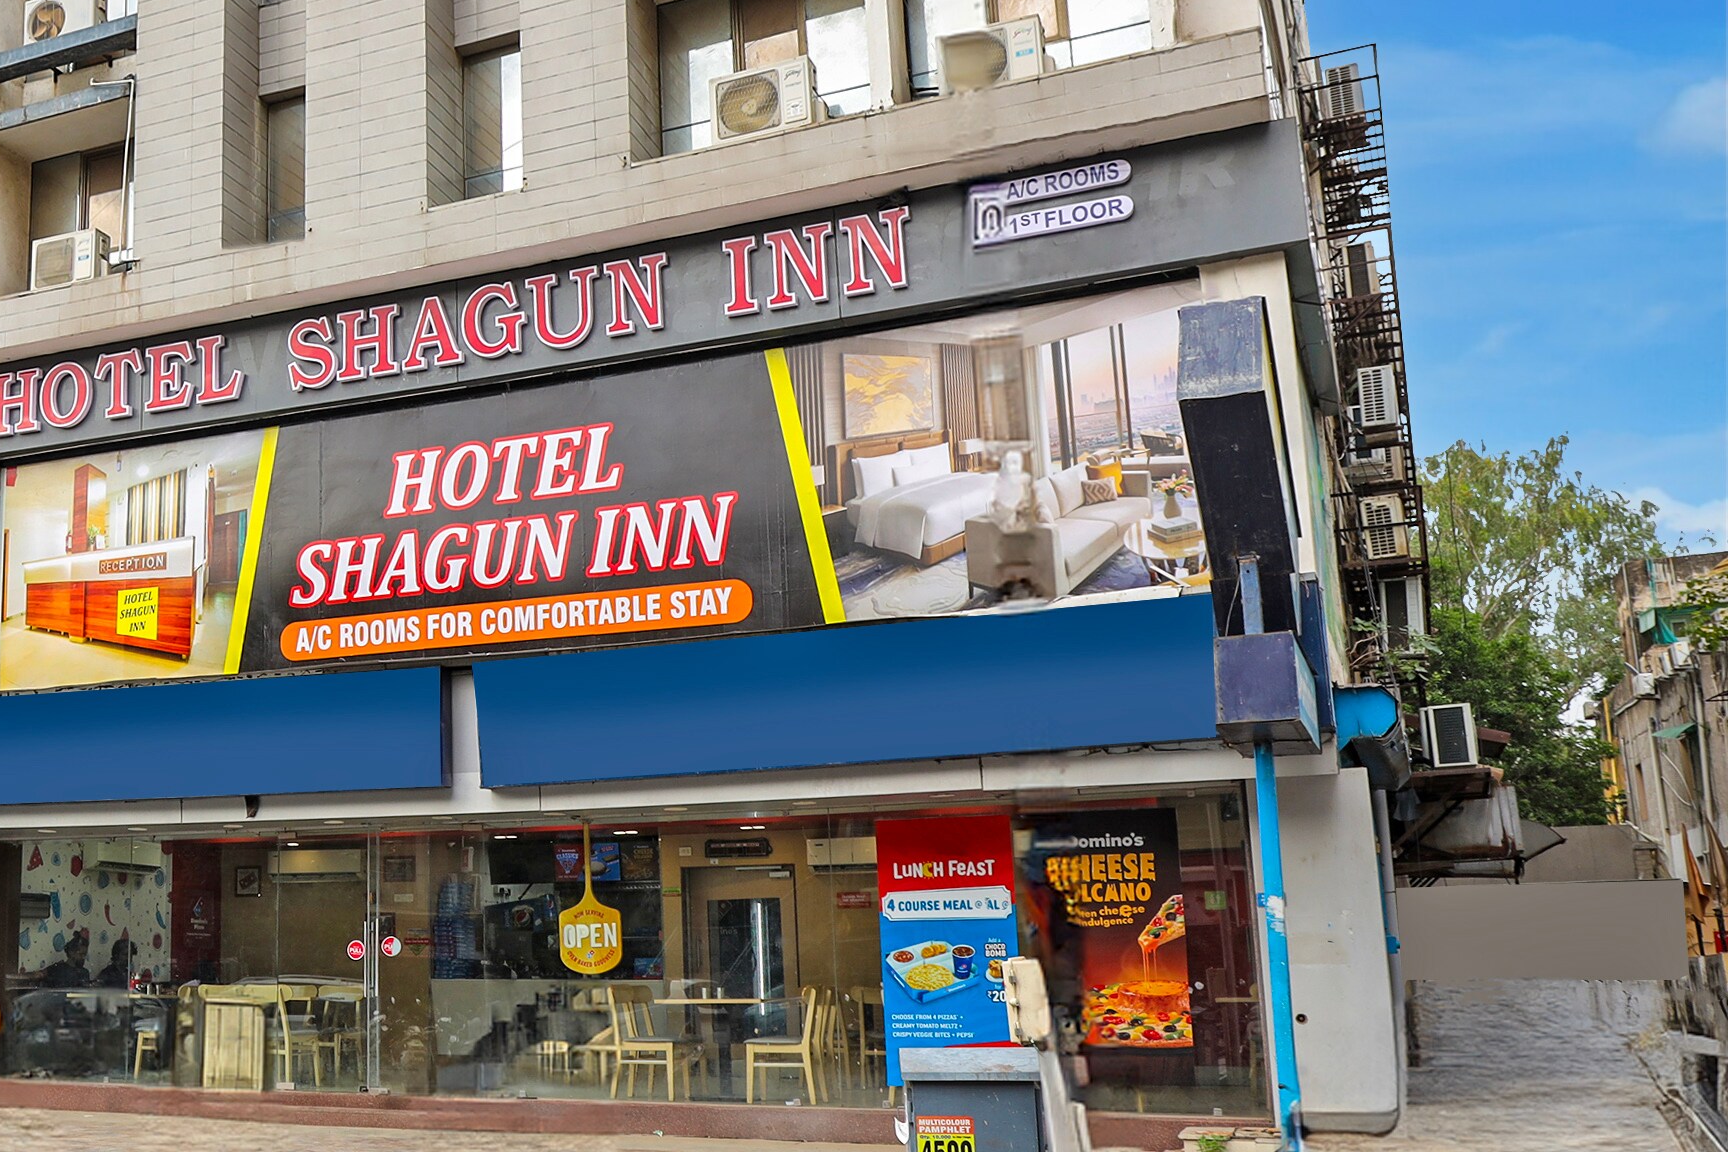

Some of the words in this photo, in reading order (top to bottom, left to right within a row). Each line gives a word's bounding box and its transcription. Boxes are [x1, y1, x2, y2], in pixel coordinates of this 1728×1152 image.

[1006, 177, 1039, 200] A/C
[1044, 162, 1120, 193] ROOMS
[1044, 198, 1125, 228] FLOOR
[287, 252, 668, 392] SHAGUN
[722, 205, 911, 317] INN
[383, 423, 624, 519] HOTEL
[288, 510, 579, 608] SHAGUN
[586, 491, 738, 578] INN
[99, 555, 165, 573] RECEPTION
[124, 591, 153, 605] HOTEL
[119, 604, 156, 620] SHAGUN
[295, 624, 333, 654] A/C
[339, 617, 421, 649] ROOMS
[427, 611, 473, 640] FOR
[485, 595, 661, 635] COMFORTABLE
[670, 587, 733, 618] STAY
[129, 620, 147, 633] INN
[1064, 853, 1156, 882] HEESE
[887, 899, 896, 912] 4
[898, 899, 940, 912] COURSE
[943, 898, 973, 911] MEAL
[1099, 904, 1145, 918] cheese
[563, 922, 618, 949] OPEN
[919, 1126, 971, 1134] PAMPHLET
